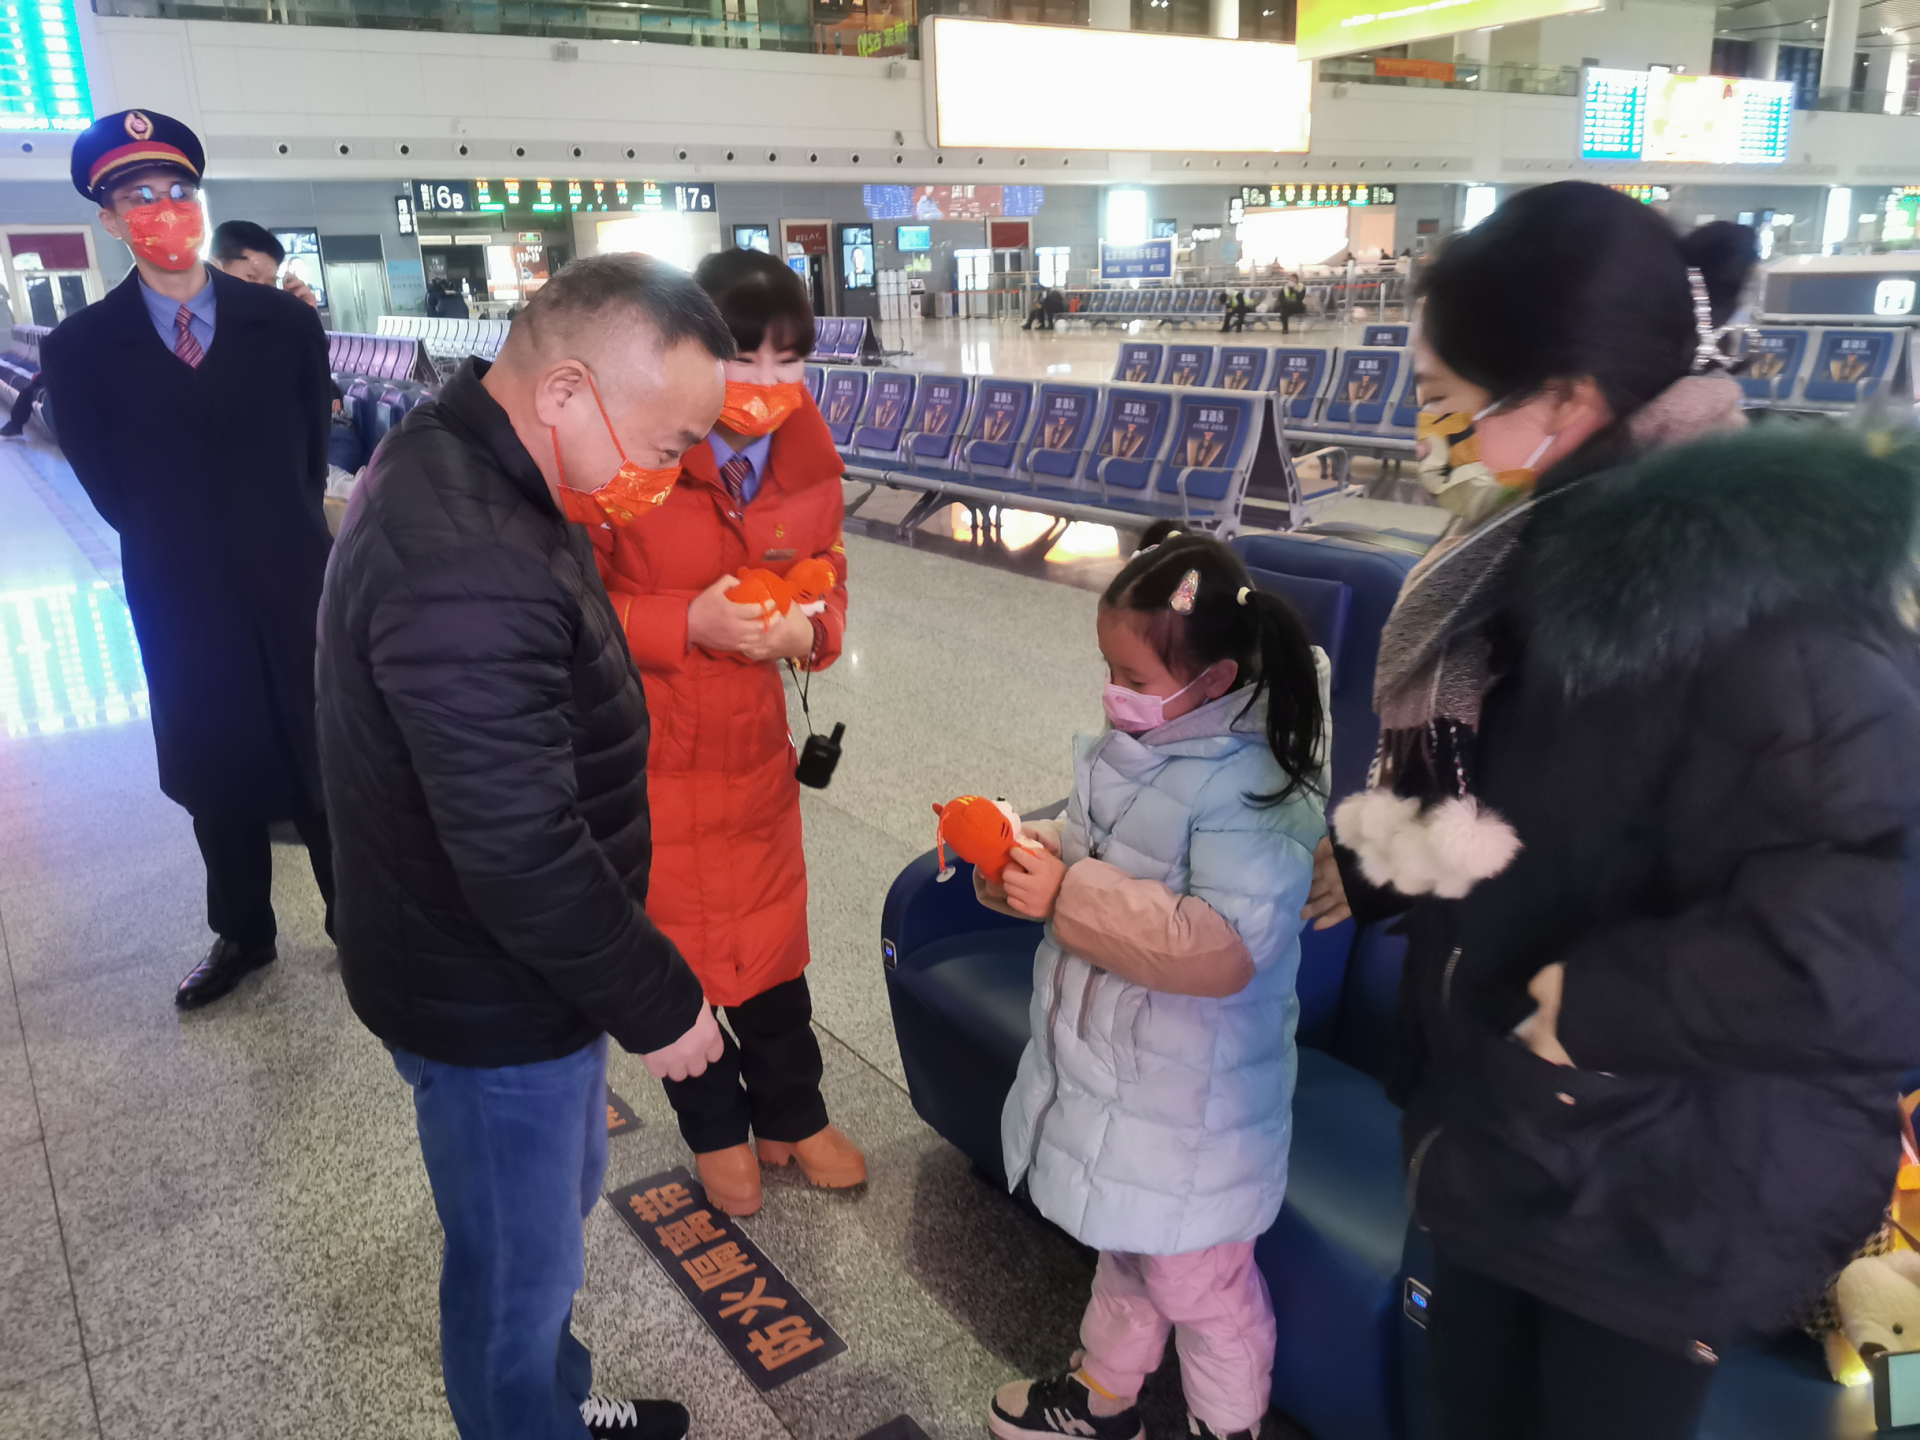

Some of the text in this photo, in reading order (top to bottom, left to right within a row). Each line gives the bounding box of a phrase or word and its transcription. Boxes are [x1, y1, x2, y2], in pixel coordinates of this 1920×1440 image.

[436, 185, 464, 209] 6B
[687, 187, 711, 209] 7B
[628, 1182, 825, 1372] 防火隔离带
